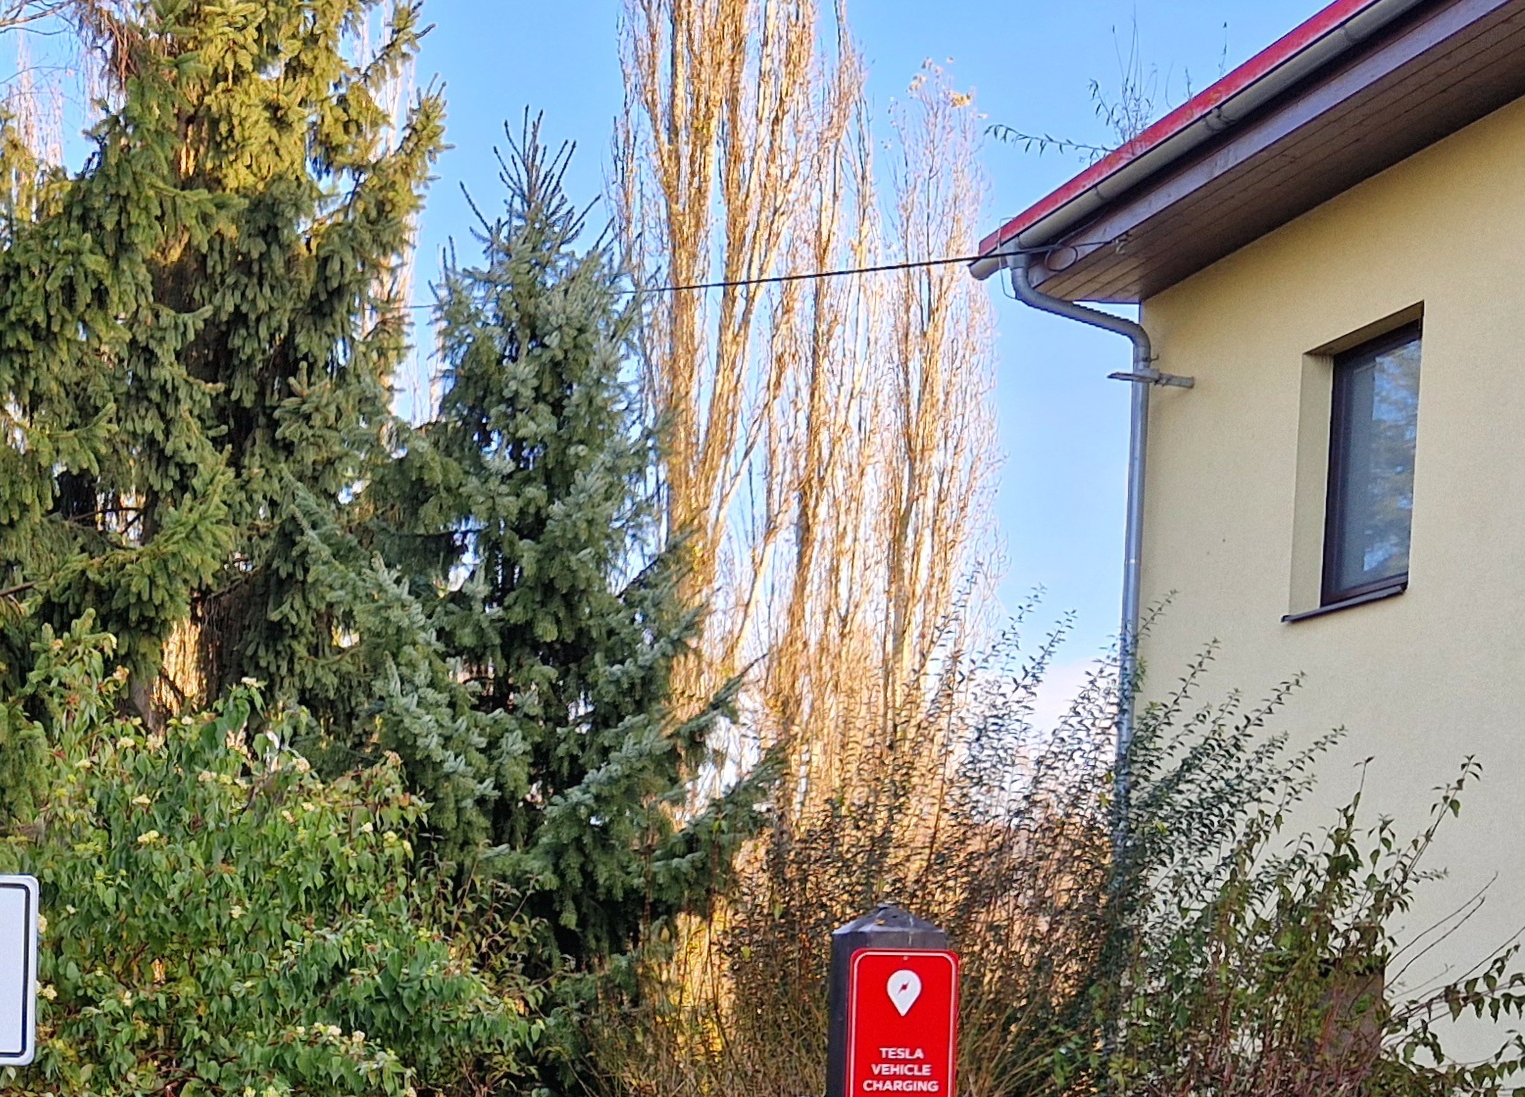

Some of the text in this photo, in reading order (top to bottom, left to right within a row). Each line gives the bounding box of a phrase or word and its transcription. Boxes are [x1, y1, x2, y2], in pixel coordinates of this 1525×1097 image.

[879, 1047, 924, 1060] TESLA
[871, 1063, 932, 1076] VEHICLE
[862, 1079, 939, 1092] CHARGING
